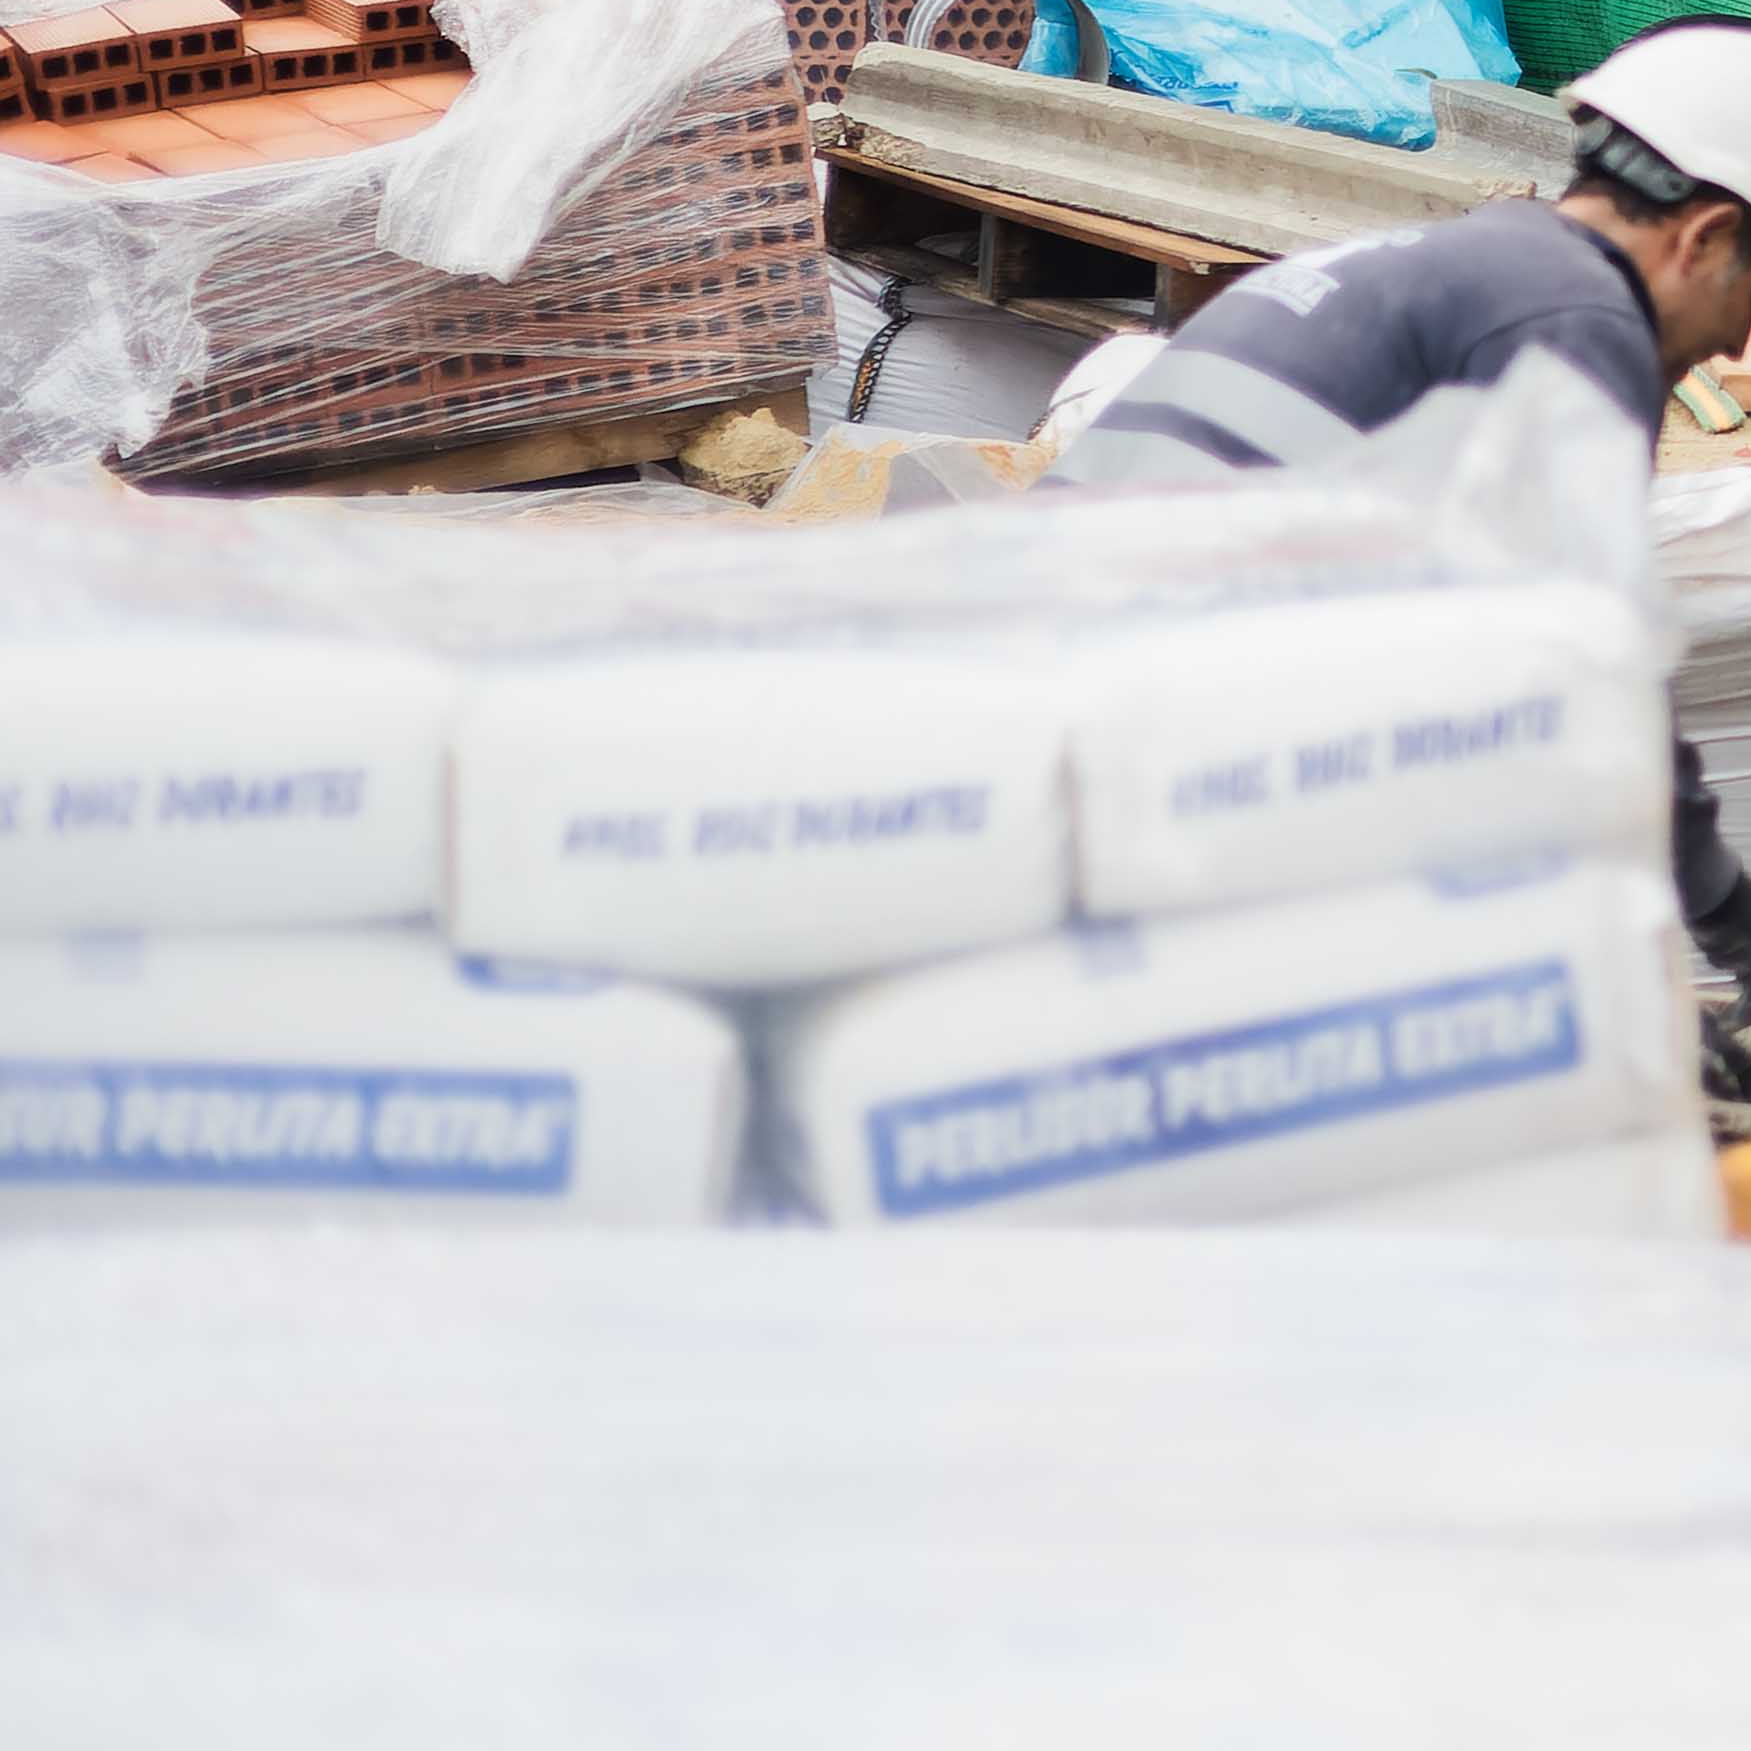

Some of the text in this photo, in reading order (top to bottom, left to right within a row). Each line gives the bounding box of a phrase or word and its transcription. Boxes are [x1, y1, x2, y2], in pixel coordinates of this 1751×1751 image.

[1158, 1025, 1384, 1130] PERLITA
[116, 1084, 366, 1162] PERLITA
[371, 1092, 568, 1170] EXTRA
